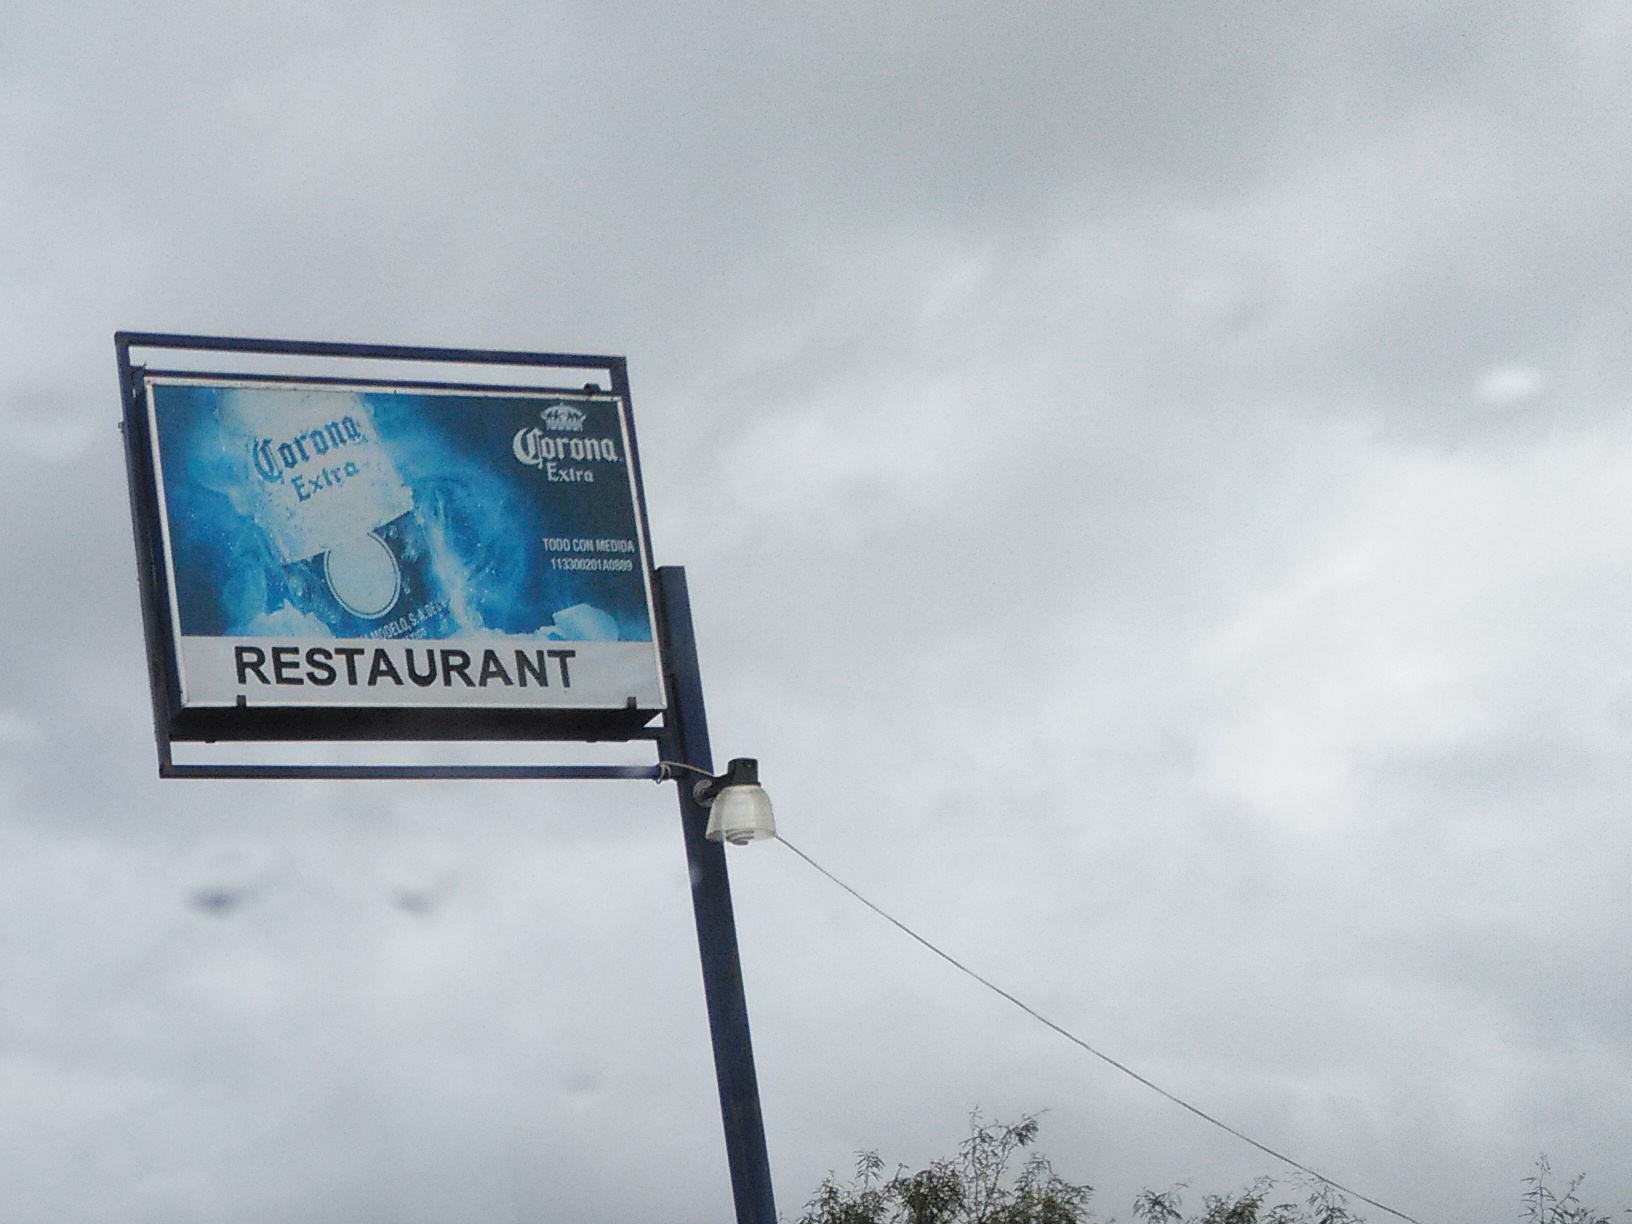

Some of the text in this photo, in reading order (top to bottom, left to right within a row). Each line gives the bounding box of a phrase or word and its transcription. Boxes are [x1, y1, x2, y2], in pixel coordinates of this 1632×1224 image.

[252, 415, 362, 485] Corona
[512, 427, 619, 470] Corona
[291, 462, 360, 502] Extra
[546, 462, 594, 483] Extra
[542, 538, 635, 554] TODO CON MEDIDA
[234, 646, 576, 688] RESTAURANT
